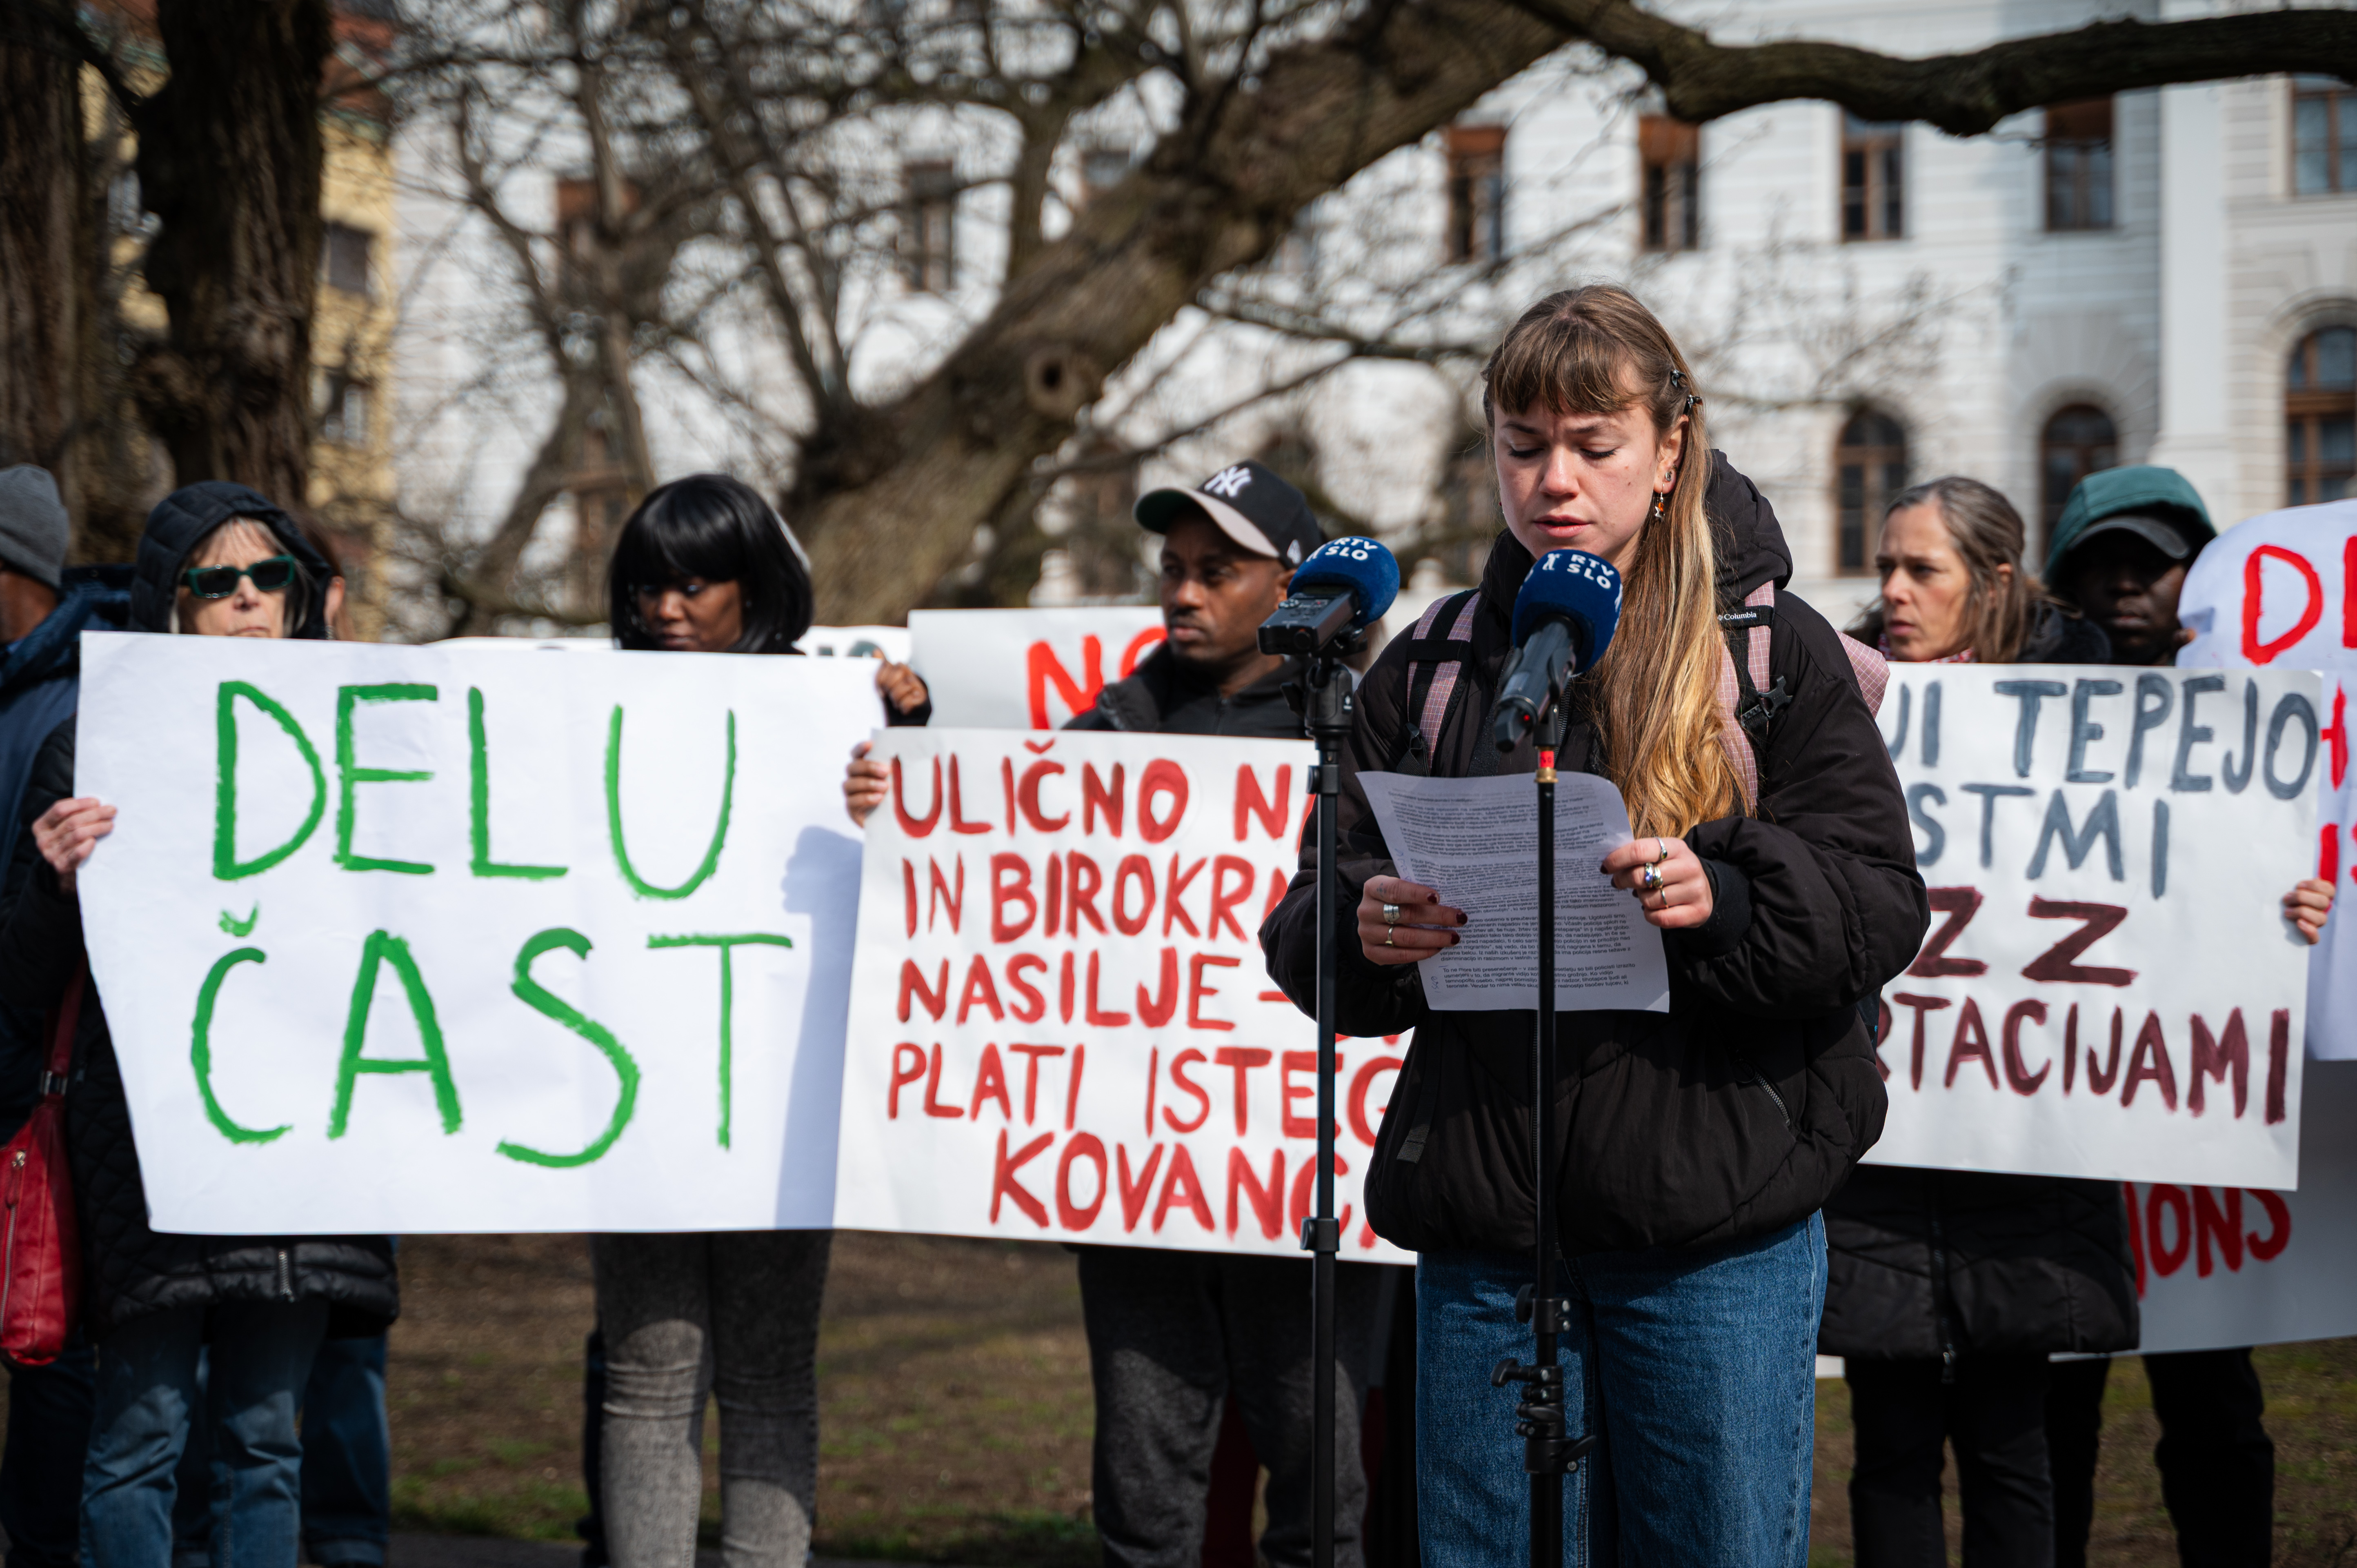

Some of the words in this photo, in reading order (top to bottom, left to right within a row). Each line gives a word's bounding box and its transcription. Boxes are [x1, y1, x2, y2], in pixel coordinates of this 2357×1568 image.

[1325, 546, 1368, 561] SLO
[1334, 537, 1378, 550] RTV
[1567, 563, 1612, 589] SLO
[1571, 554, 1614, 577] RTV
[1723, 611, 1757, 620] Columbia
[1994, 673, 2319, 800] TEPEJO
[213, 680, 735, 900] DELU
[891, 738, 1189, 843] ULIČNO
[1906, 782, 2170, 899] STMI
[901, 851, 965, 939] IN
[896, 947, 1241, 1029] NASILJE
[191, 902, 793, 1168] ČAST
[887, 1042, 1085, 1131] PLATI
[989, 1129, 1376, 1250] KOVANC
